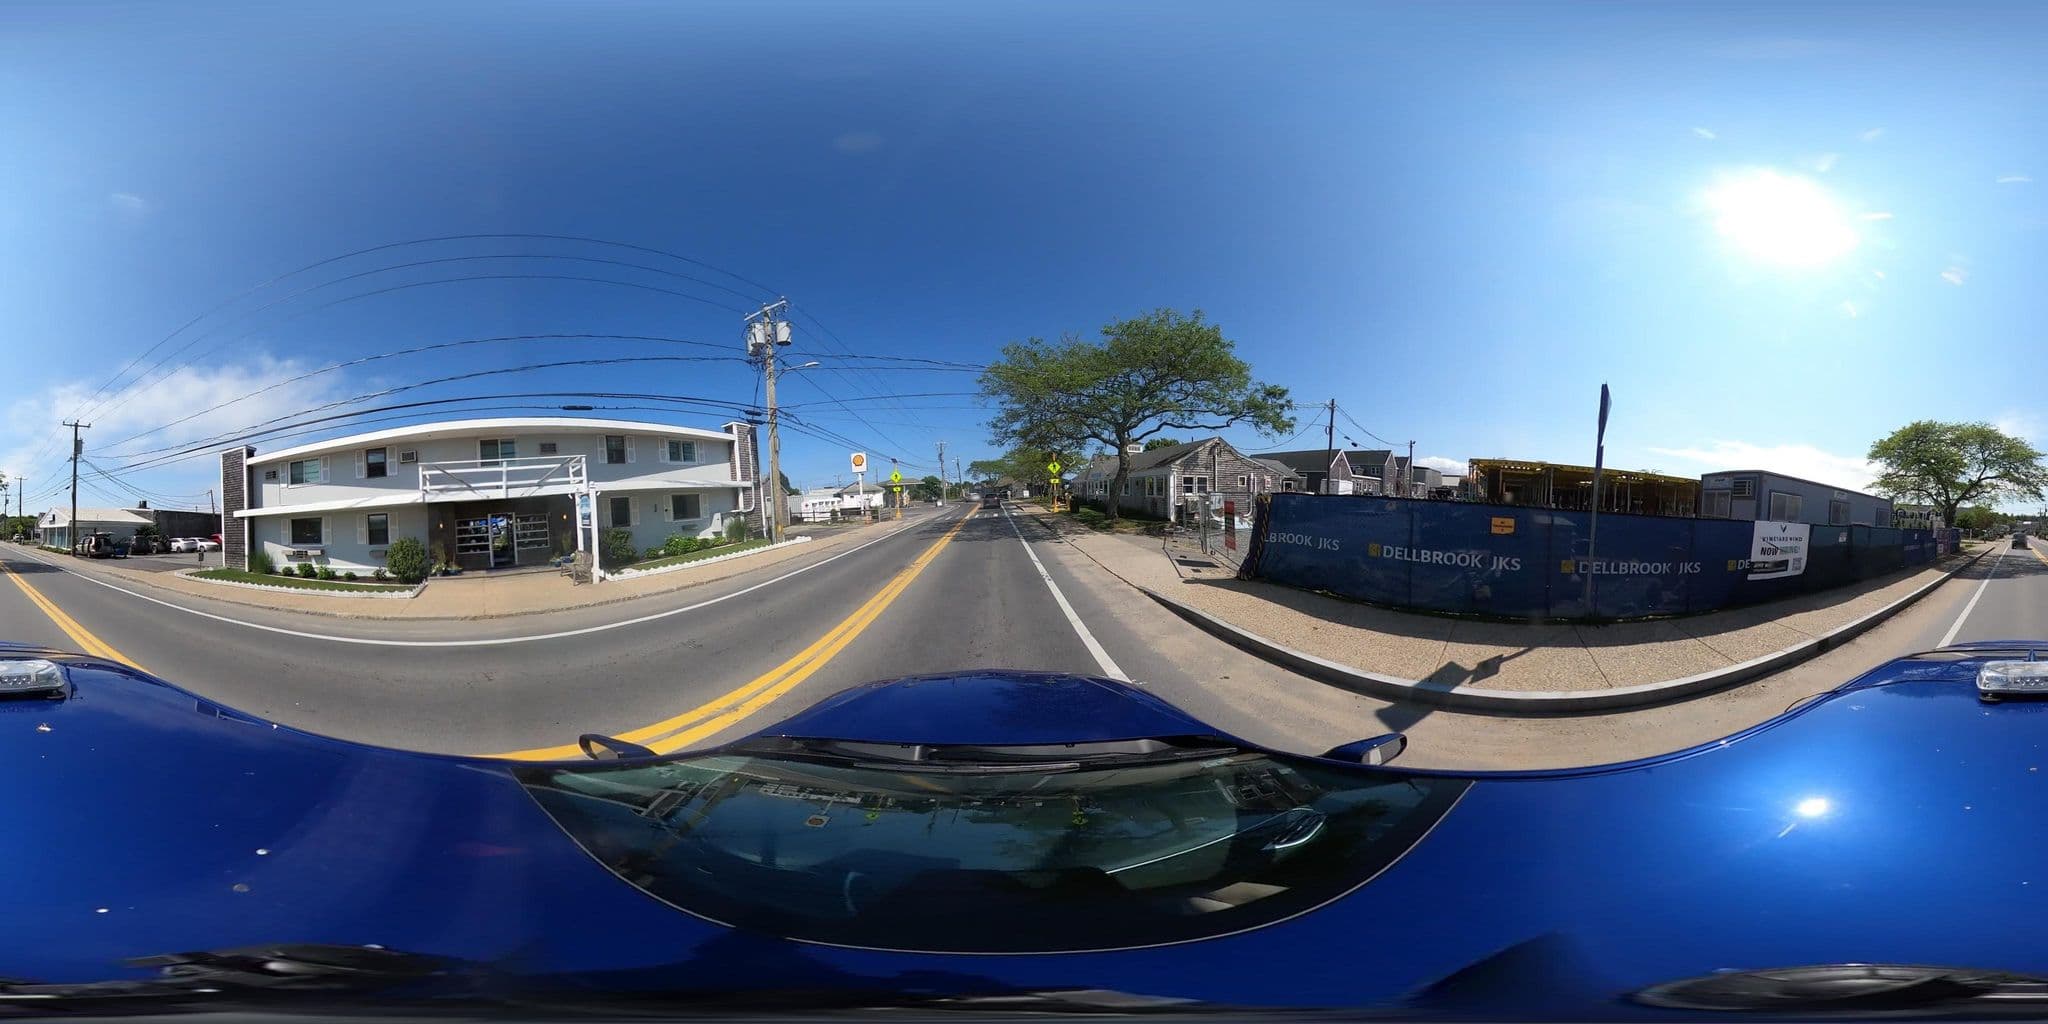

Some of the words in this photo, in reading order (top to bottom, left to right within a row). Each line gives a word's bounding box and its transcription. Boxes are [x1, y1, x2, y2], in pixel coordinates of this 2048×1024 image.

[1318, 537, 1340, 551] JKS
[1383, 545, 1482, 568] DELLBROOK
[1491, 556, 1521, 571] JKS
[1760, 547, 1779, 556] NOW
[1579, 561, 1671, 575] DELLBROOK
[1679, 561, 1701, 575] JKS
